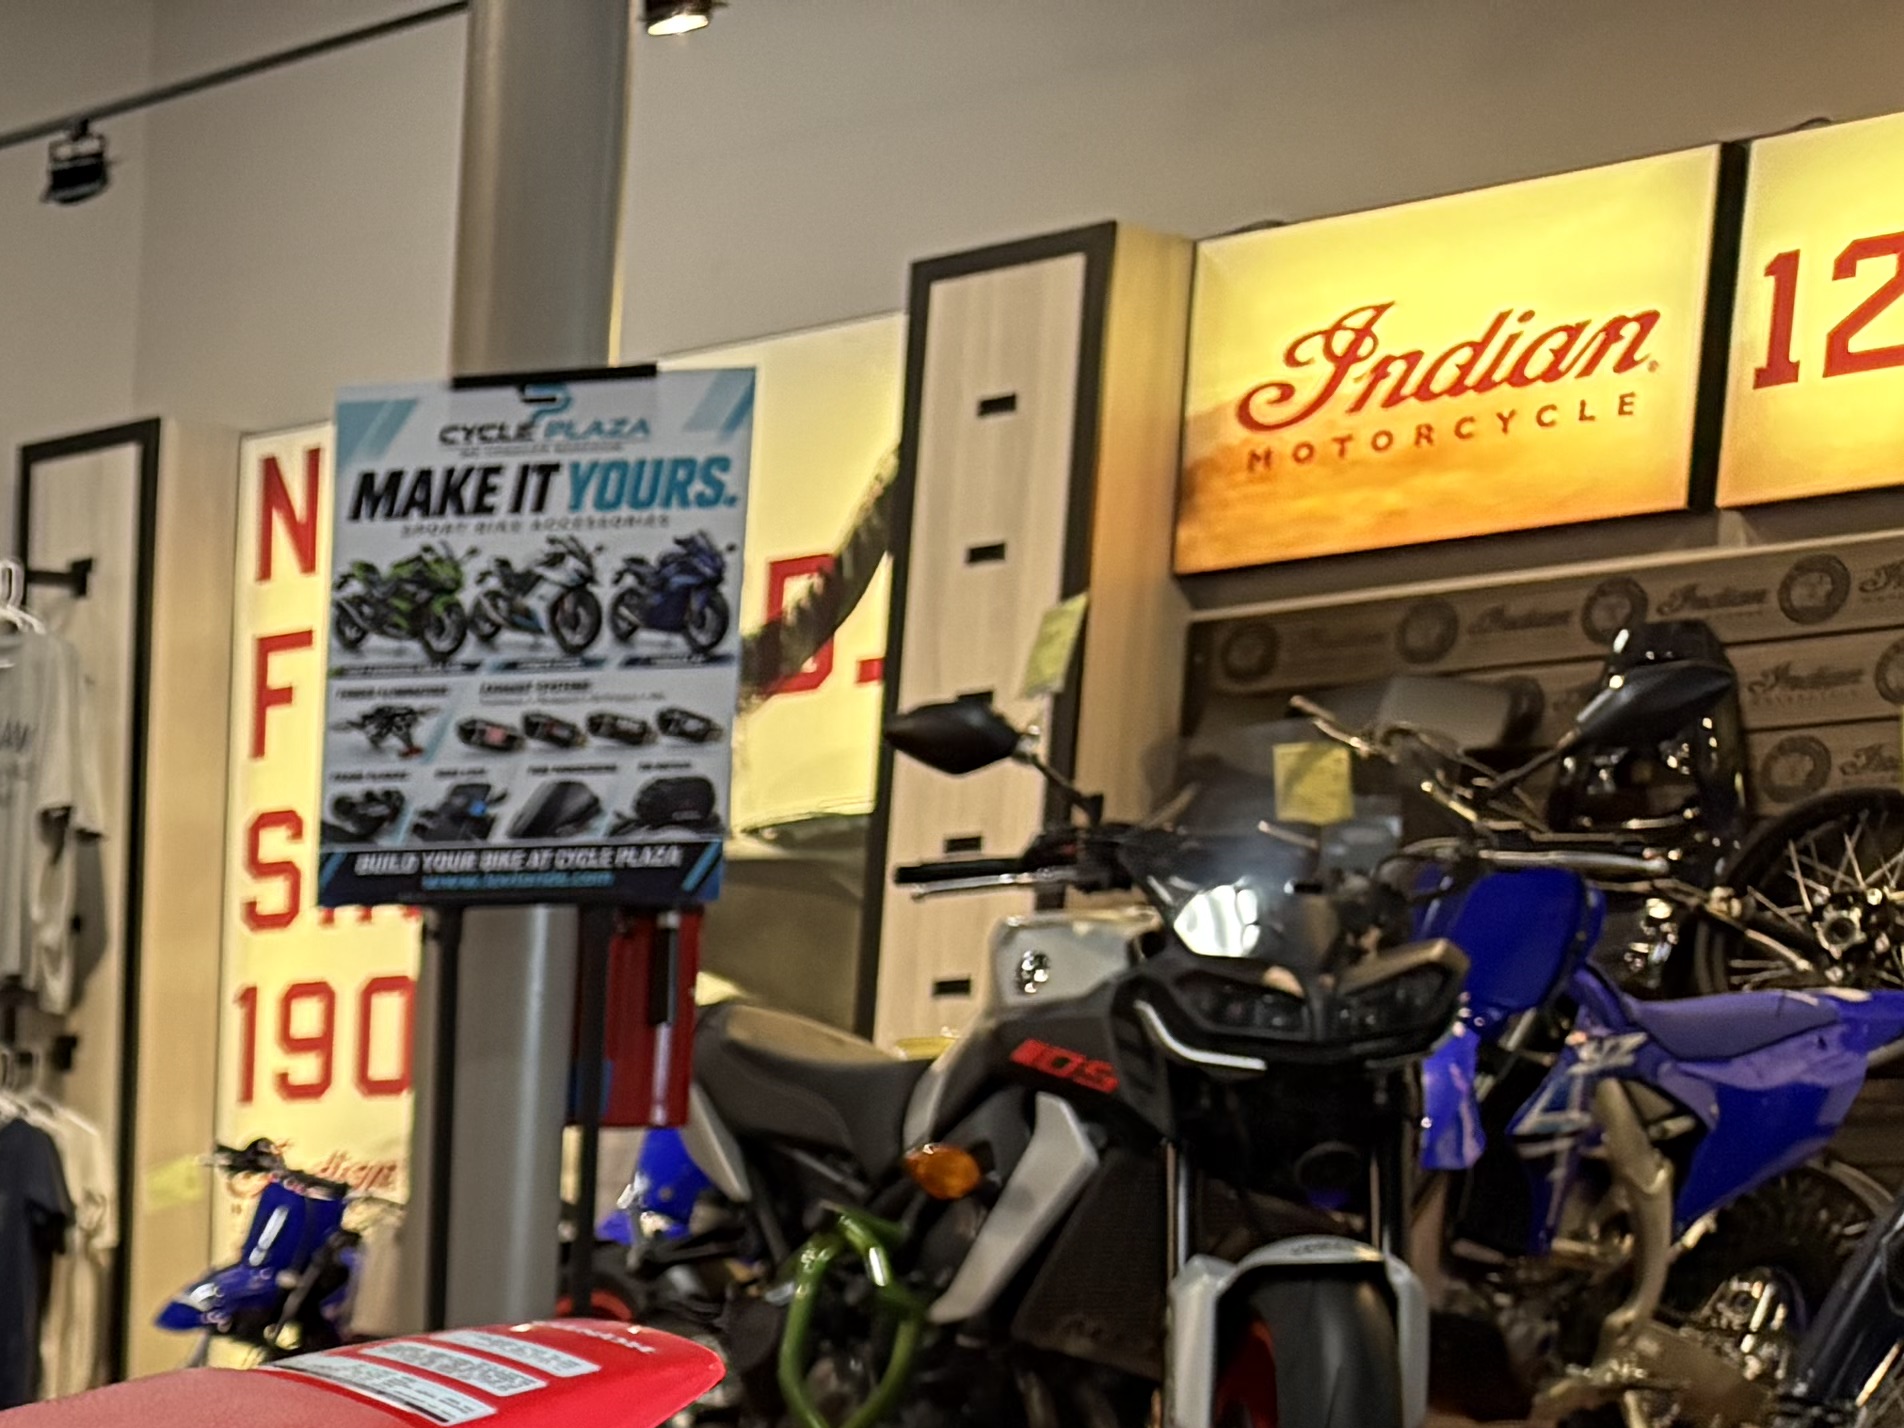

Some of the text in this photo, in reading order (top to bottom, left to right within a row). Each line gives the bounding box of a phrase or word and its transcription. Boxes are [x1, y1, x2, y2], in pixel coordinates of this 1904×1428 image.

[1236, 301, 1660, 433] Indian
[438, 417, 651, 445] CYCLE PLAZA
[1248, 392, 1636, 473] MOTORCYCLE
[347, 465, 506, 522] MAKE
[508, 461, 562, 514] IT
[566, 455, 737, 514] YOURS.
[421, 850, 479, 873] YOUR
[554, 846, 614, 870] CYCLE
[614, 844, 684, 868] PLAZA
